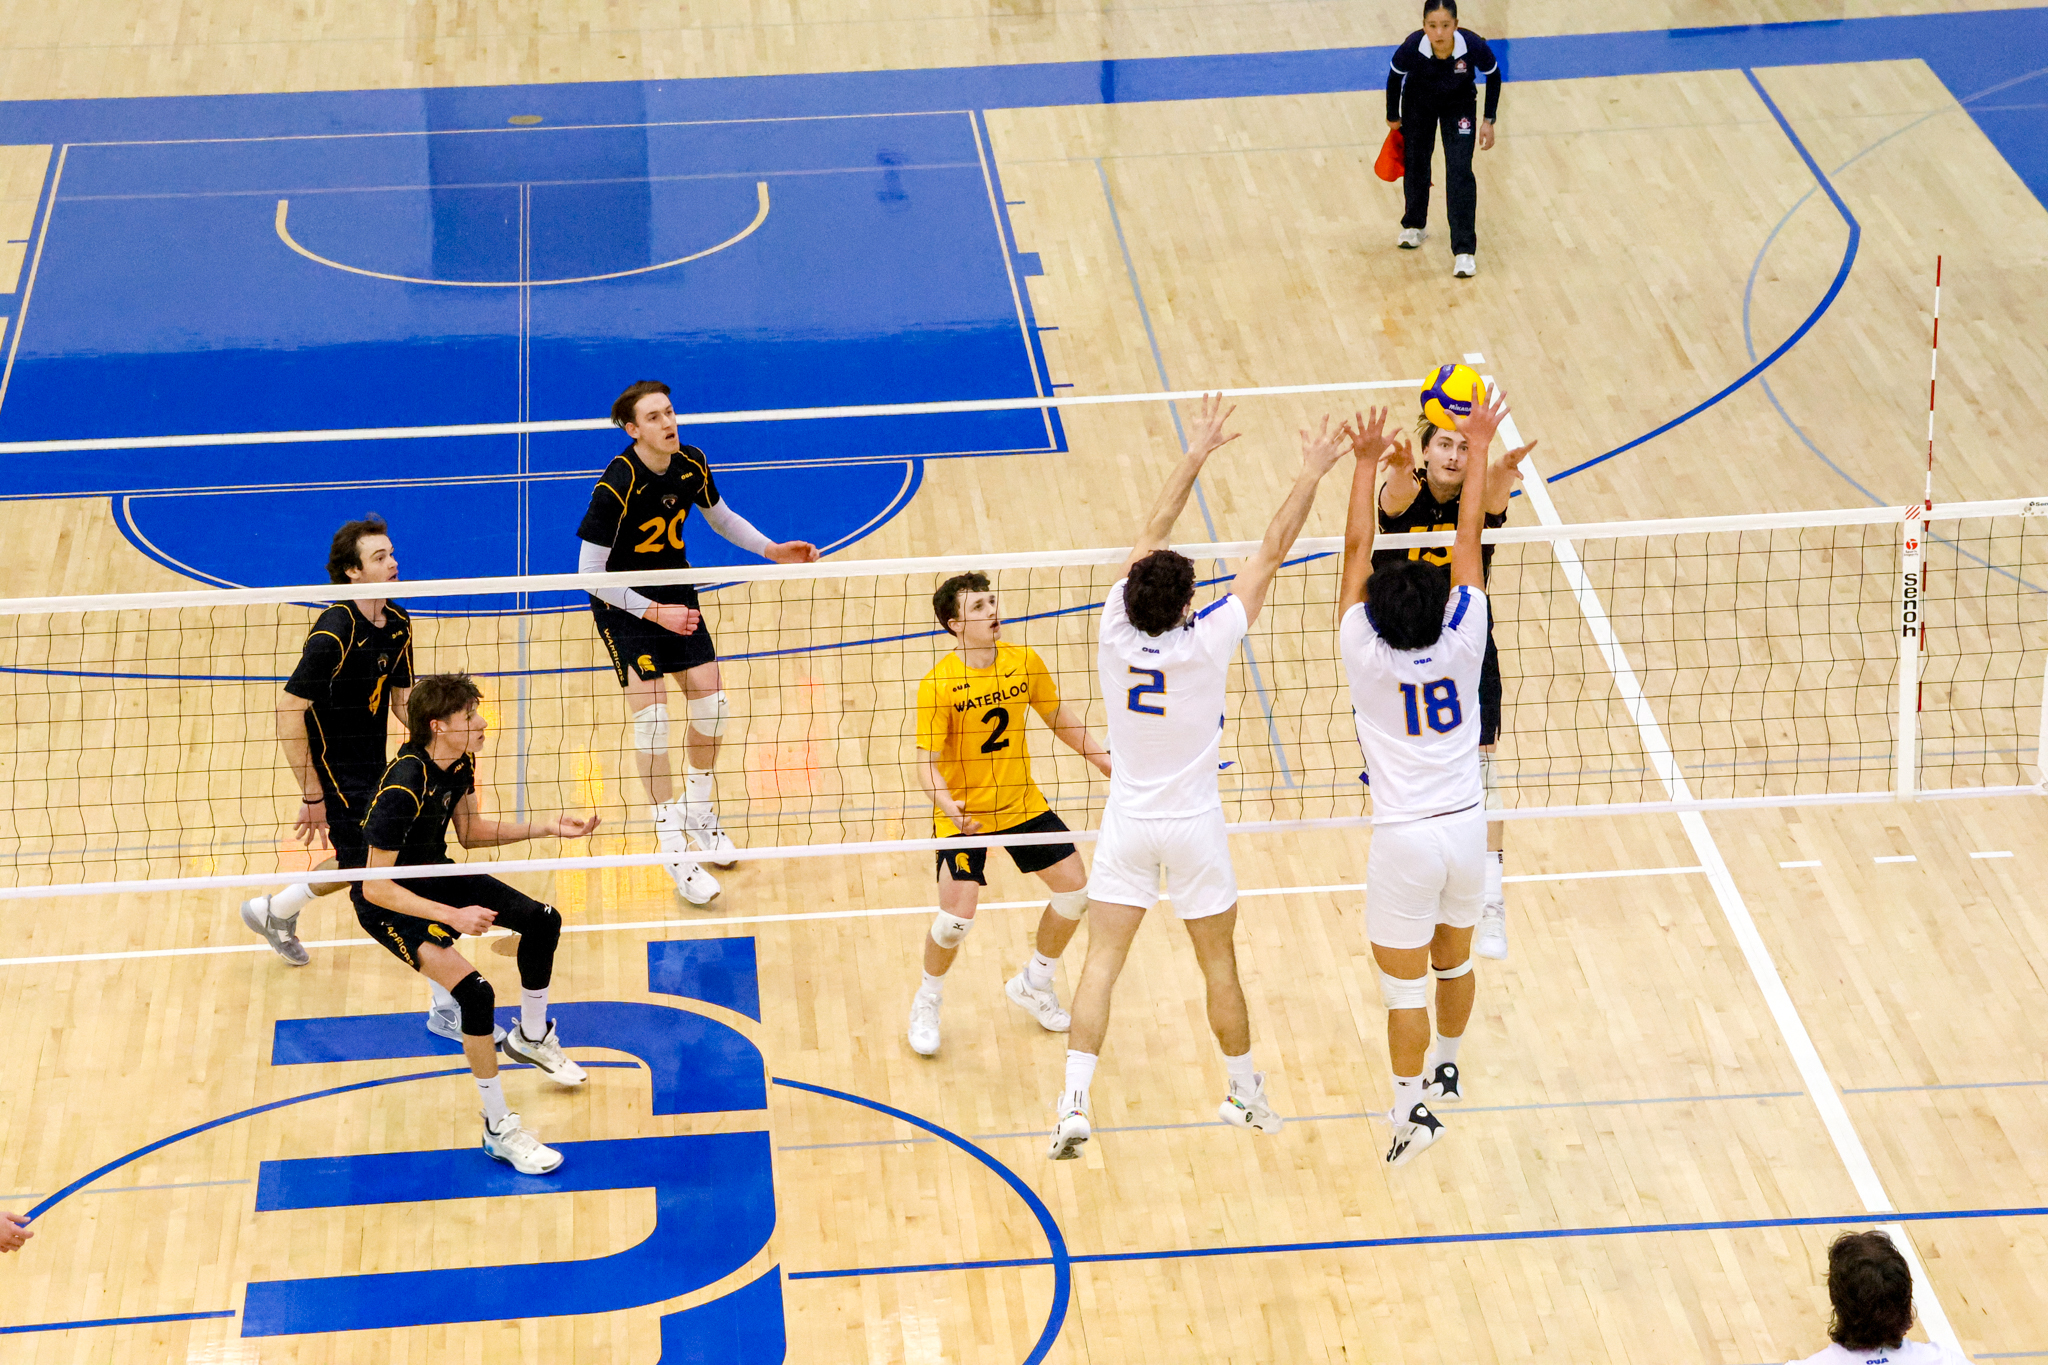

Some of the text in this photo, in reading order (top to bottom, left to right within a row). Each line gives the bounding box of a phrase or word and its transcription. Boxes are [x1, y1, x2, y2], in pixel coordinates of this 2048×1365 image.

[634, 508, 686, 554] 20
[1902, 573, 1918, 638] Senoh
[603, 627, 625, 682] WARRIORS
[1141, 646, 1160, 655] OUA
[952, 681, 971, 693] OUA
[953, 681, 1029, 714] WATERLOO
[1127, 665, 1167, 718] 2
[1398, 676, 1463, 737] 18
[980, 707, 1010, 754] 2
